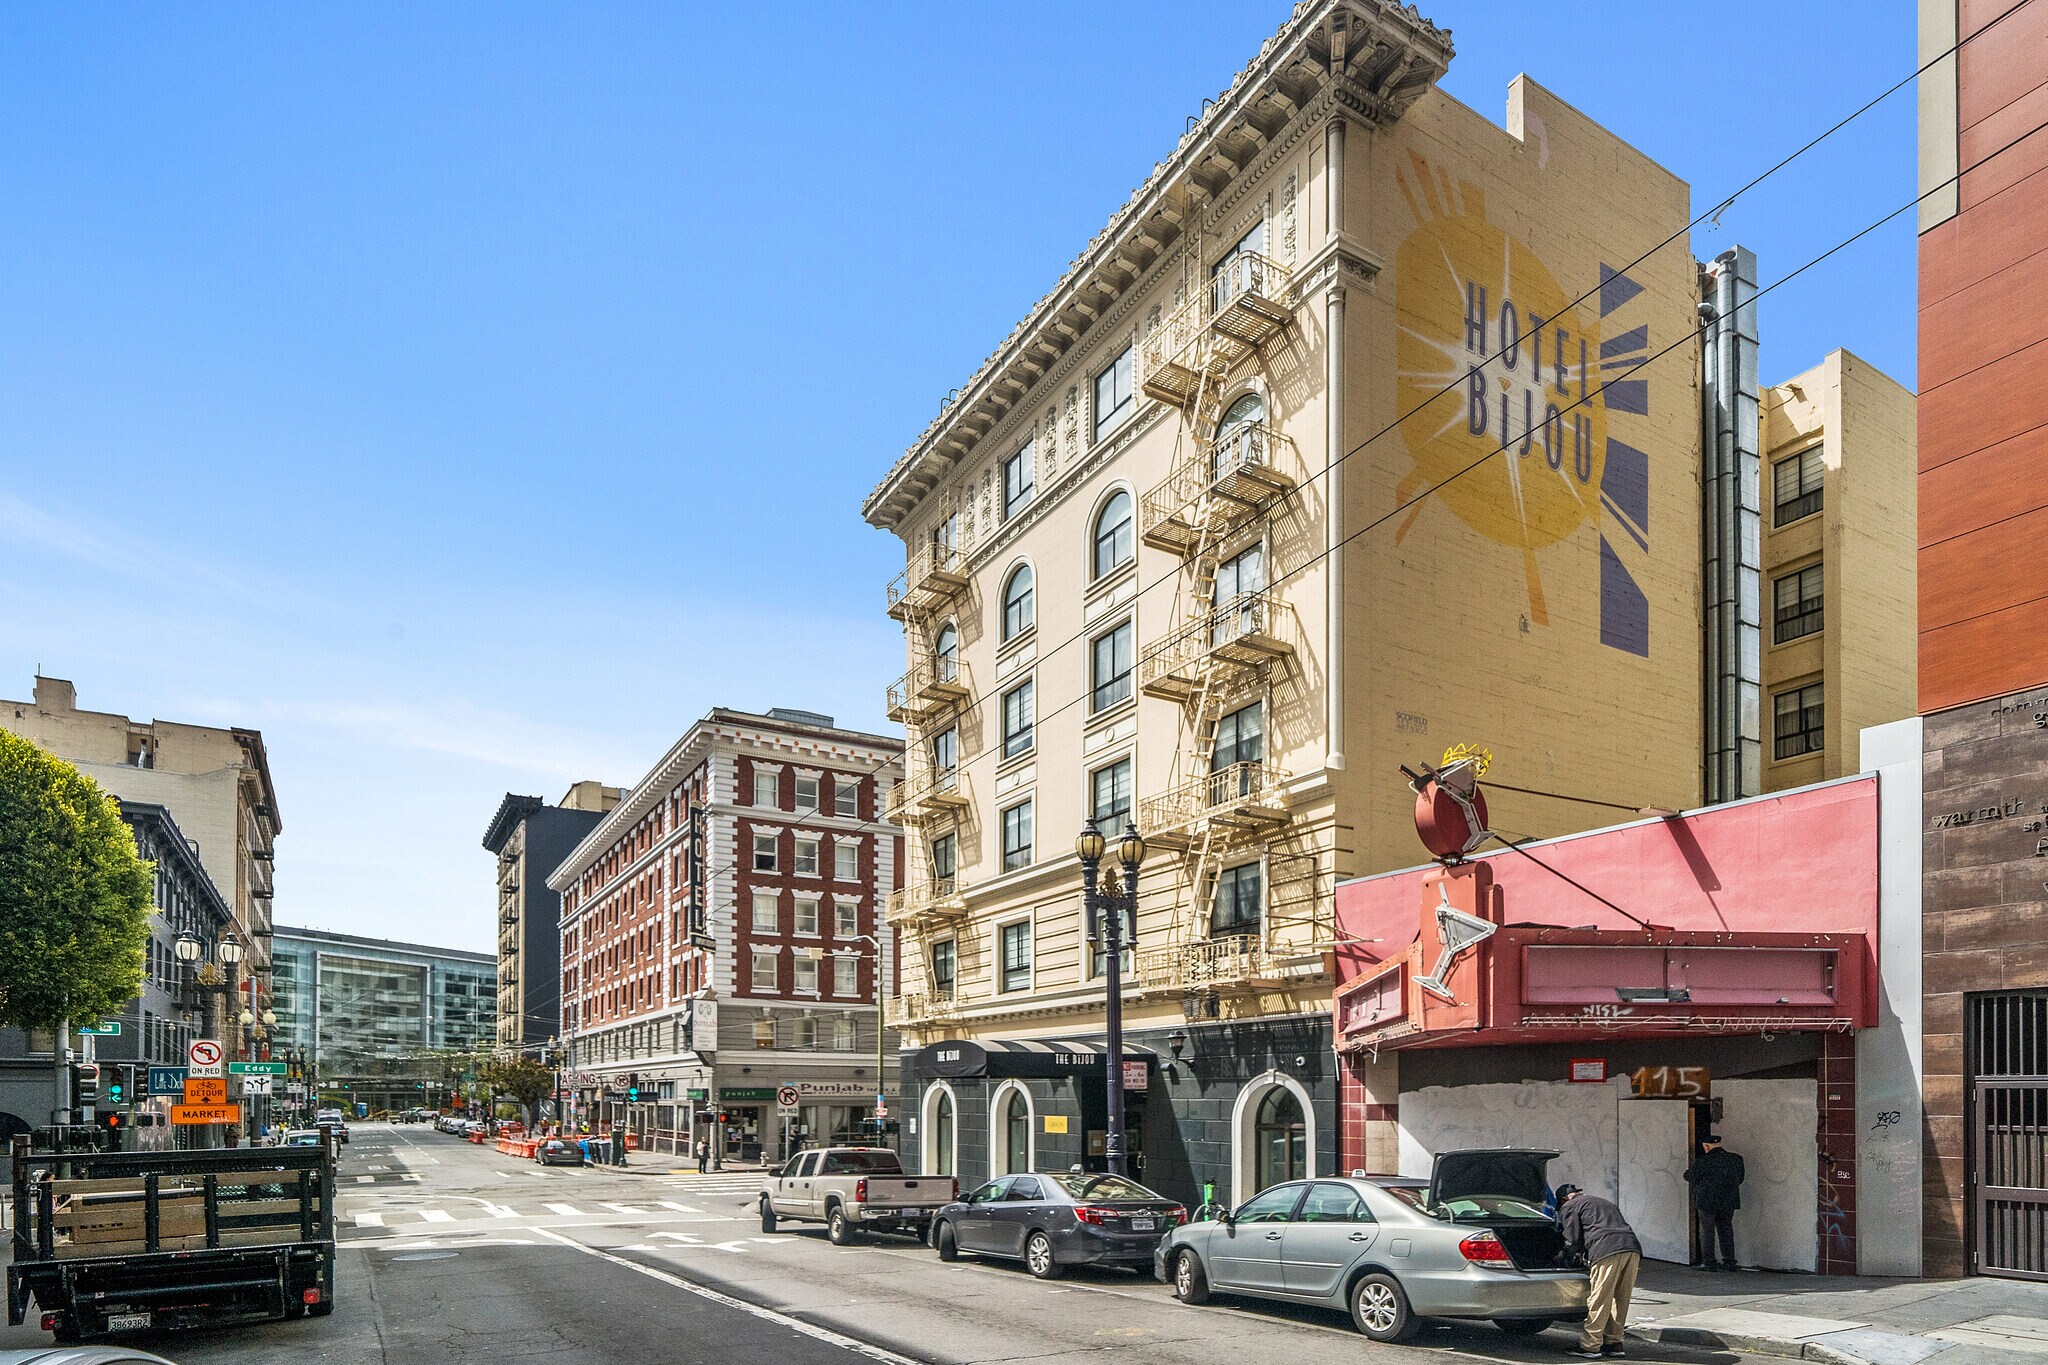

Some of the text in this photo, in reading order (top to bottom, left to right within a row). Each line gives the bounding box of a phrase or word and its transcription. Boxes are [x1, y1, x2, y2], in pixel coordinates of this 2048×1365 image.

[1464, 280, 1593, 408] HOTEL
[1396, 711, 1427, 725] SCOFIELD
[1932, 797, 2025, 828] warmth
[694, 813, 703, 930] HOTEL
[1055, 1053, 1070, 1065] THE
[245, 1065, 272, 1073] Eddy
[560, 1073, 595, 1085] PAING
[191, 1089, 223, 1097] DETOUR
[800, 1083, 864, 1093] Punjab
[183, 1110, 227, 1118] MARKET
